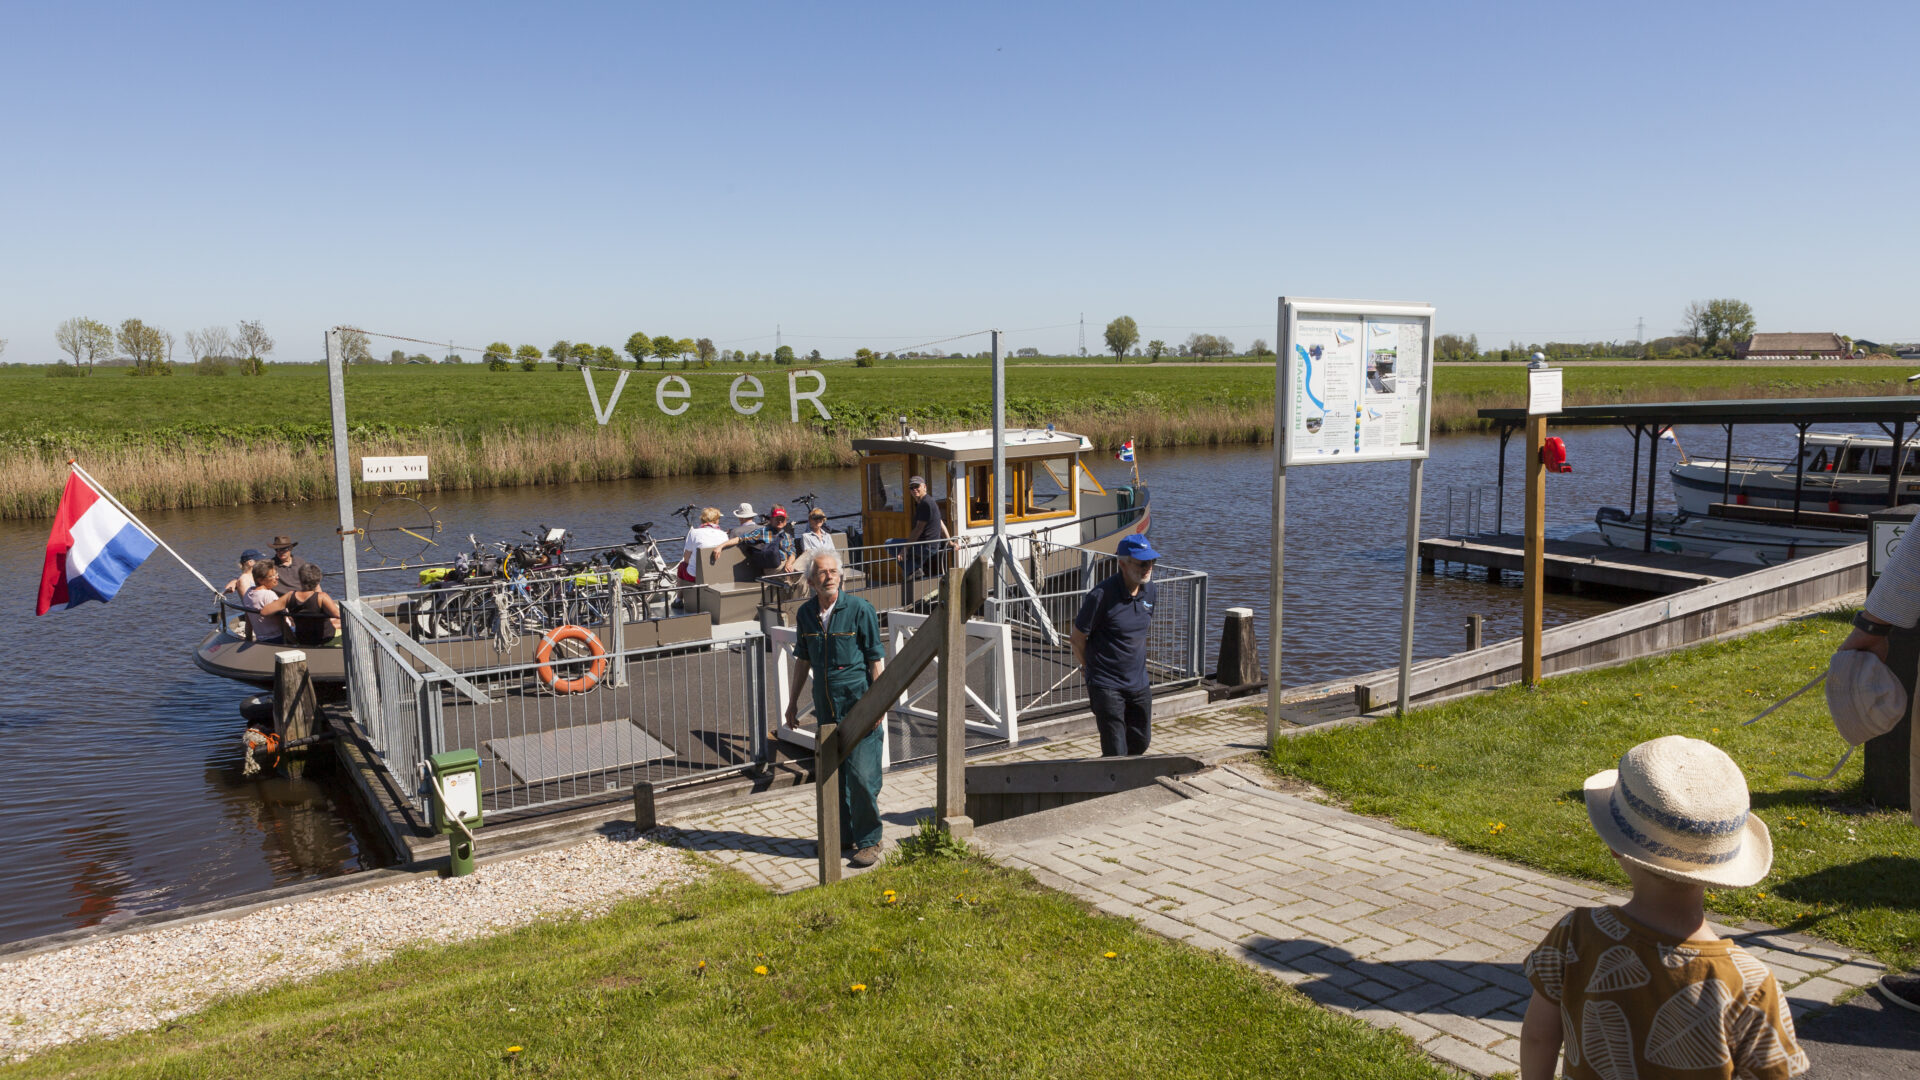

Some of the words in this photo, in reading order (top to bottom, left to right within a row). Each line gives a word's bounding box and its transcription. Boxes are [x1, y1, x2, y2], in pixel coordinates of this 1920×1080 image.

[1296, 346, 1304, 430] REITDIEPVEER
[395, 482, 407, 494] 12
[436, 520, 442, 532] 3
[358, 528, 365, 542] 9
[401, 559, 408, 570] 6
